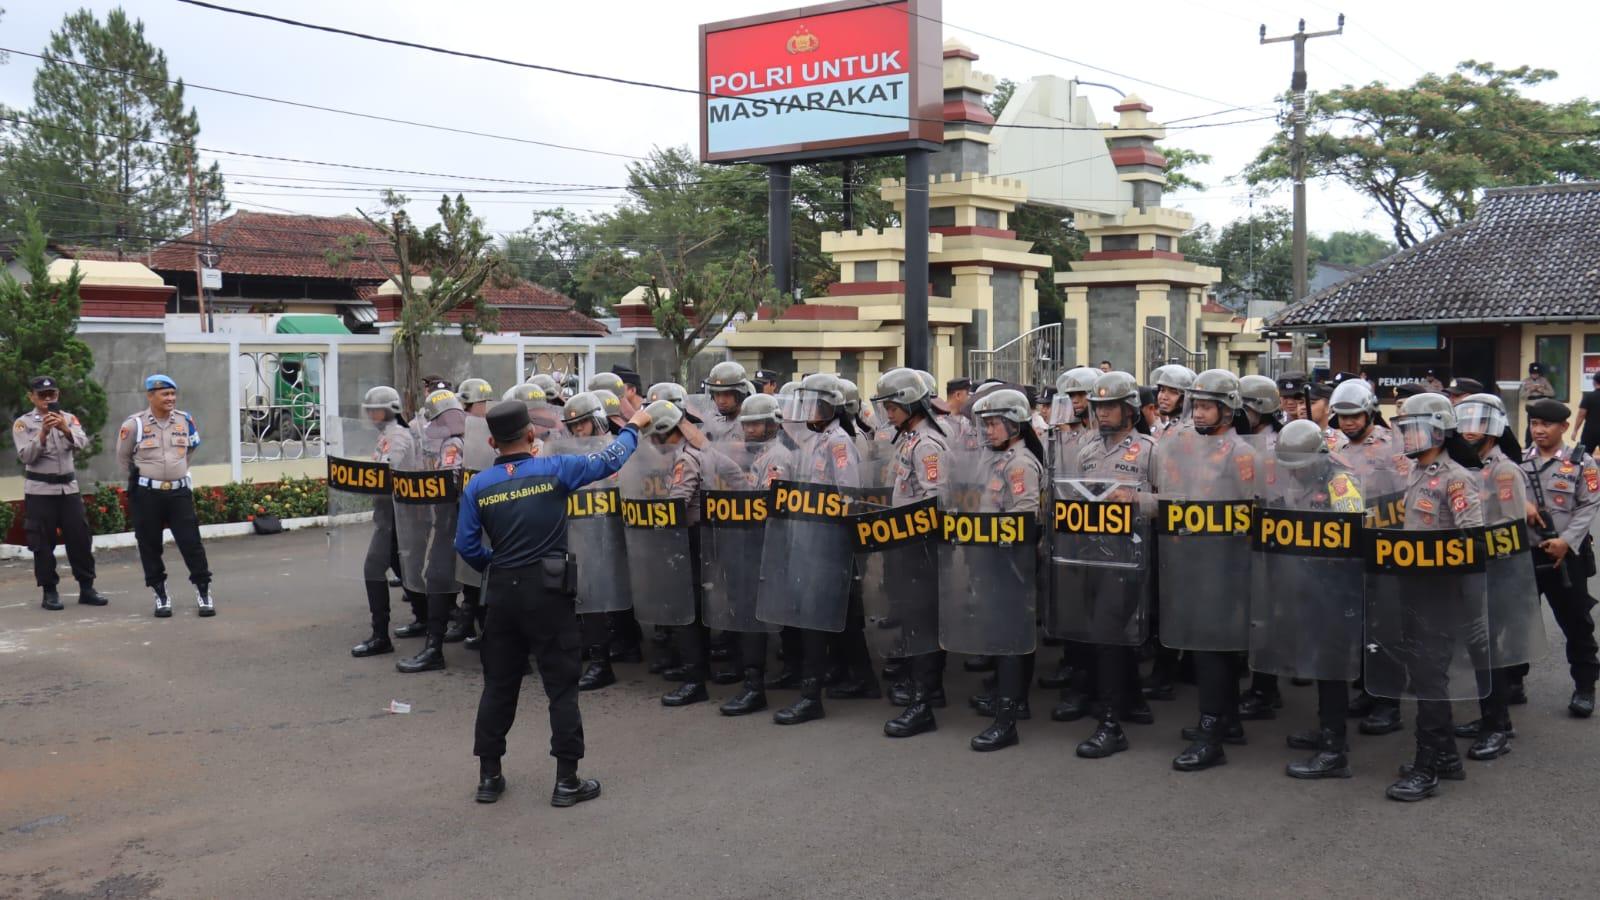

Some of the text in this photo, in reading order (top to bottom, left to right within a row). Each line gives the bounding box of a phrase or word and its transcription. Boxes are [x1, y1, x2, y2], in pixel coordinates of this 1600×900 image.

[710, 50, 901, 94] POLRI UNTUK
[709, 81, 903, 123] MASYARAKAT
[331, 463, 385, 488] POLISI
[393, 477, 446, 498] POLISI
[478, 482, 553, 508] PUSDIK SABHARA
[568, 490, 616, 517] LISI
[775, 488, 849, 517] POLISI
[621, 502, 677, 527] POLISI
[706, 498, 768, 522] POLIS
[1055, 502, 1131, 534] POLISI
[1167, 504, 1251, 533] POLIS
[857, 506, 939, 545] POLISI
[943, 515, 1025, 543] POLISI
[1261, 518, 1351, 548] POLISI
[1376, 538, 1474, 567] POLISI
[1485, 525, 1520, 557] ISI
